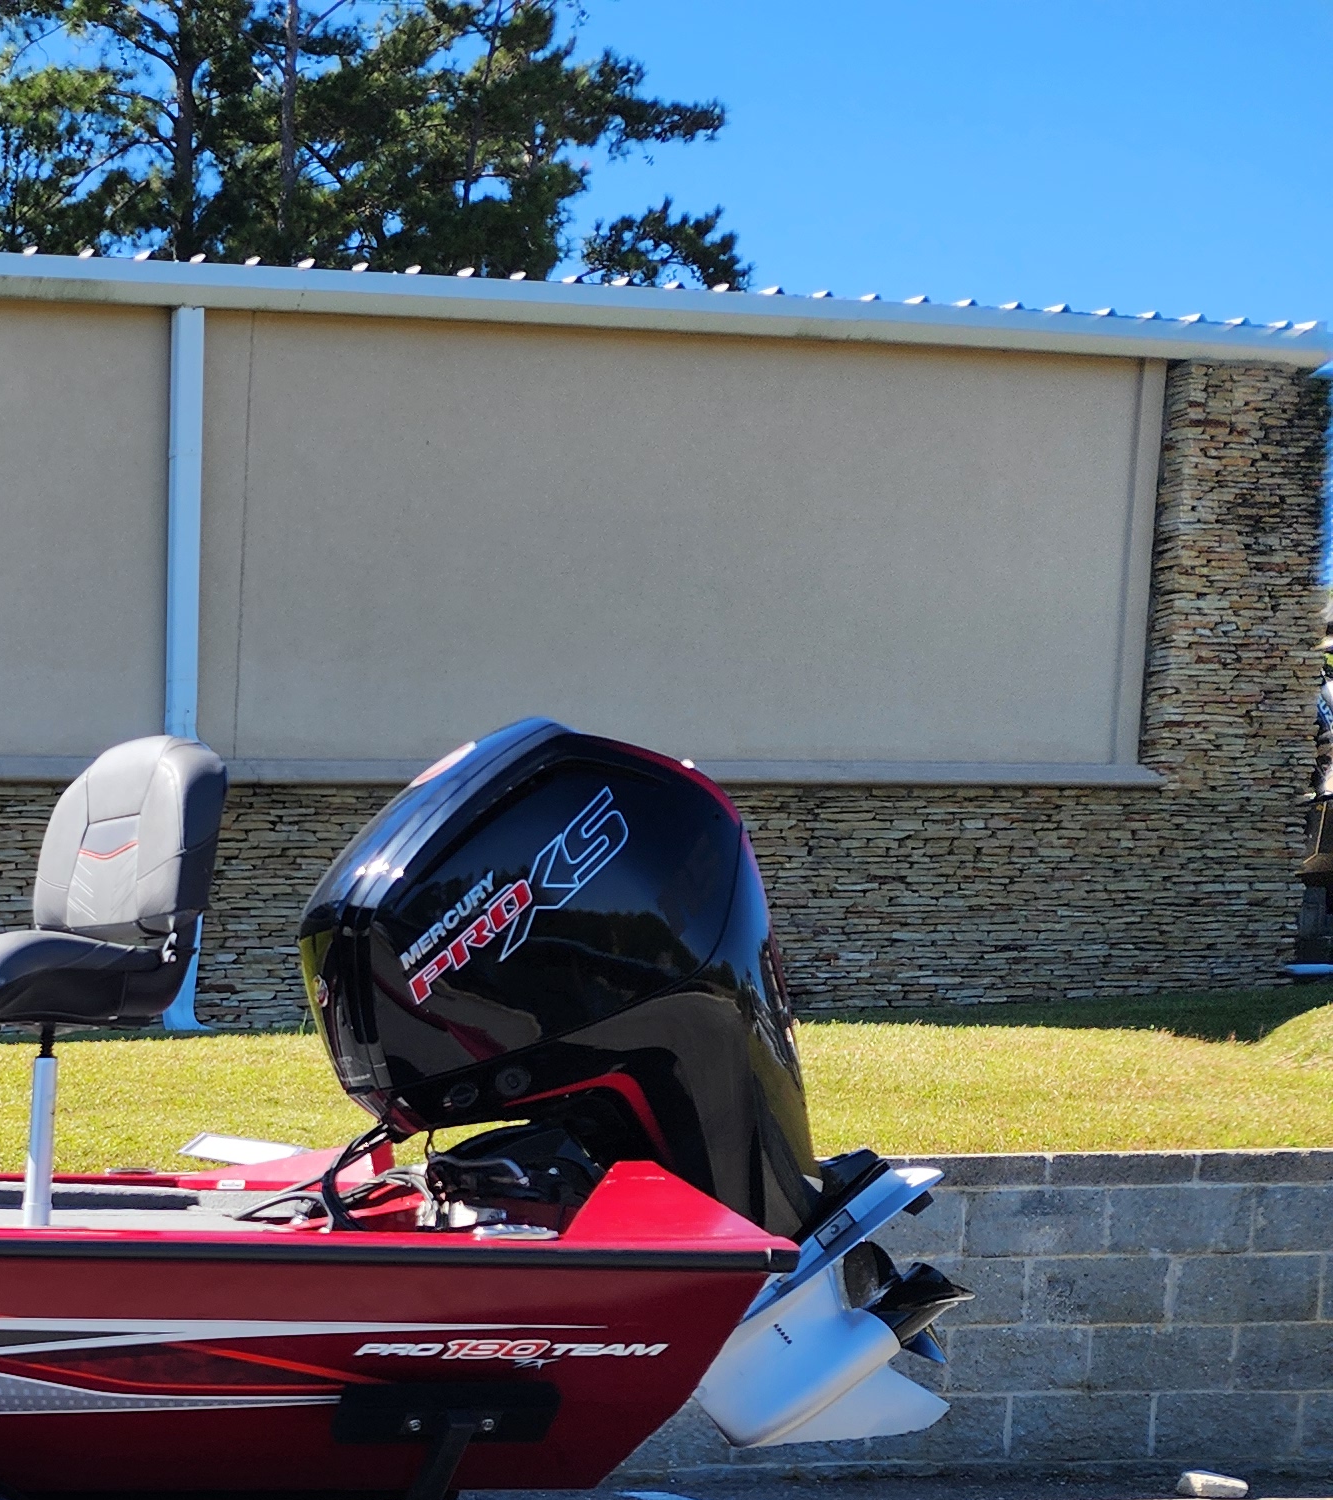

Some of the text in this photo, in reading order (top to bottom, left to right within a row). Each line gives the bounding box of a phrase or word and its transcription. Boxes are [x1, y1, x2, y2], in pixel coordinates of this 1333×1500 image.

[399, 869, 494, 971] MERCURY
[408, 785, 629, 1005] PRO XS
[353, 1339, 669, 1360] PRO 190 TEAM
